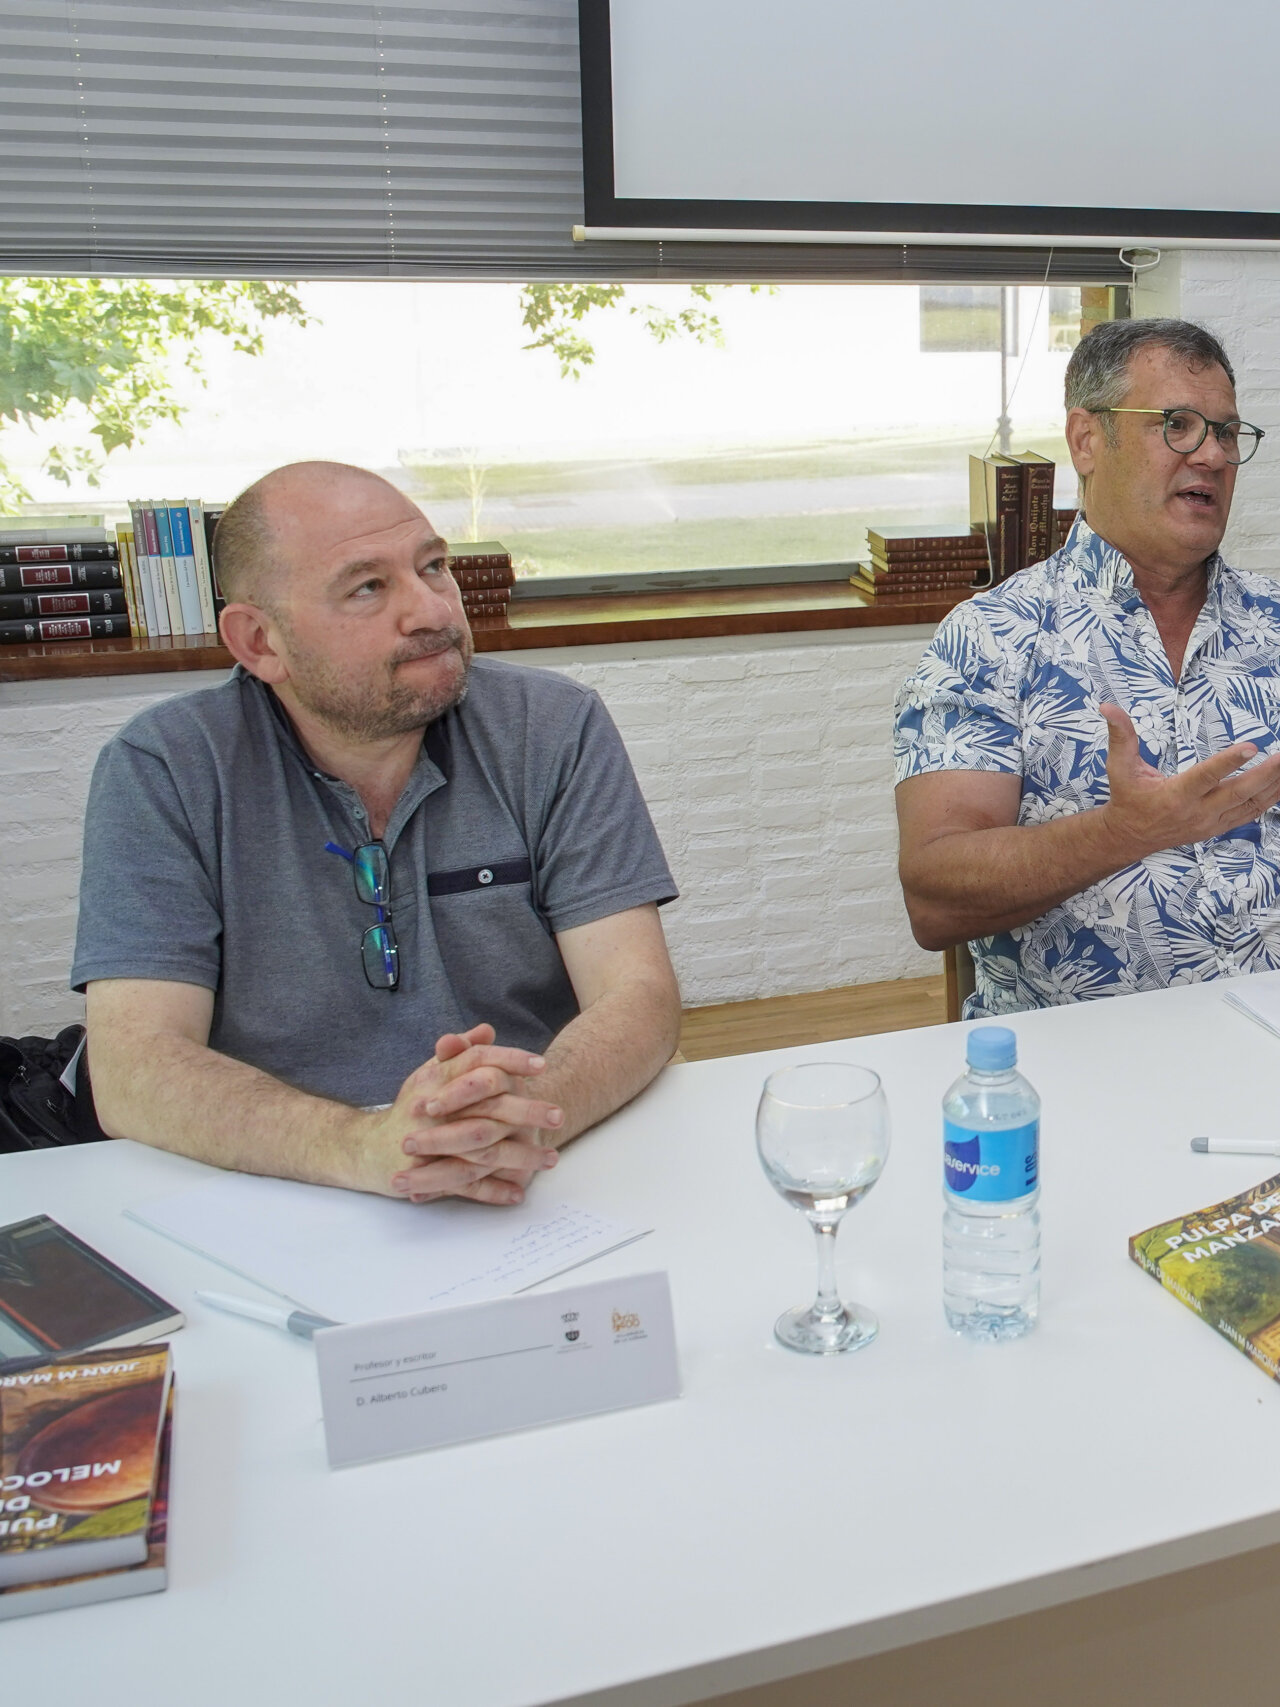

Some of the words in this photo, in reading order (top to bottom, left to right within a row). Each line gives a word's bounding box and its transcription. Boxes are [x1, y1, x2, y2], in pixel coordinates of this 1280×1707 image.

[945, 1153, 1001, 1176] aservice
[1164, 1212, 1252, 1249] PULPA
[1134, 1249, 1156, 1273] PULPA
[1155, 1265, 1166, 1283] DE
[1165, 1274, 1202, 1312] MANZANA
[1217, 1319, 1239, 1342] JUAN
[1236, 1335, 1247, 1349] M
[0, 1372, 53, 1387] MAR
[58, 1369, 77, 1380] M
[82, 1361, 140, 1377] JUAN
[0, 1459, 122, 1490] MELOC
[0, 1495, 31, 1513] D
